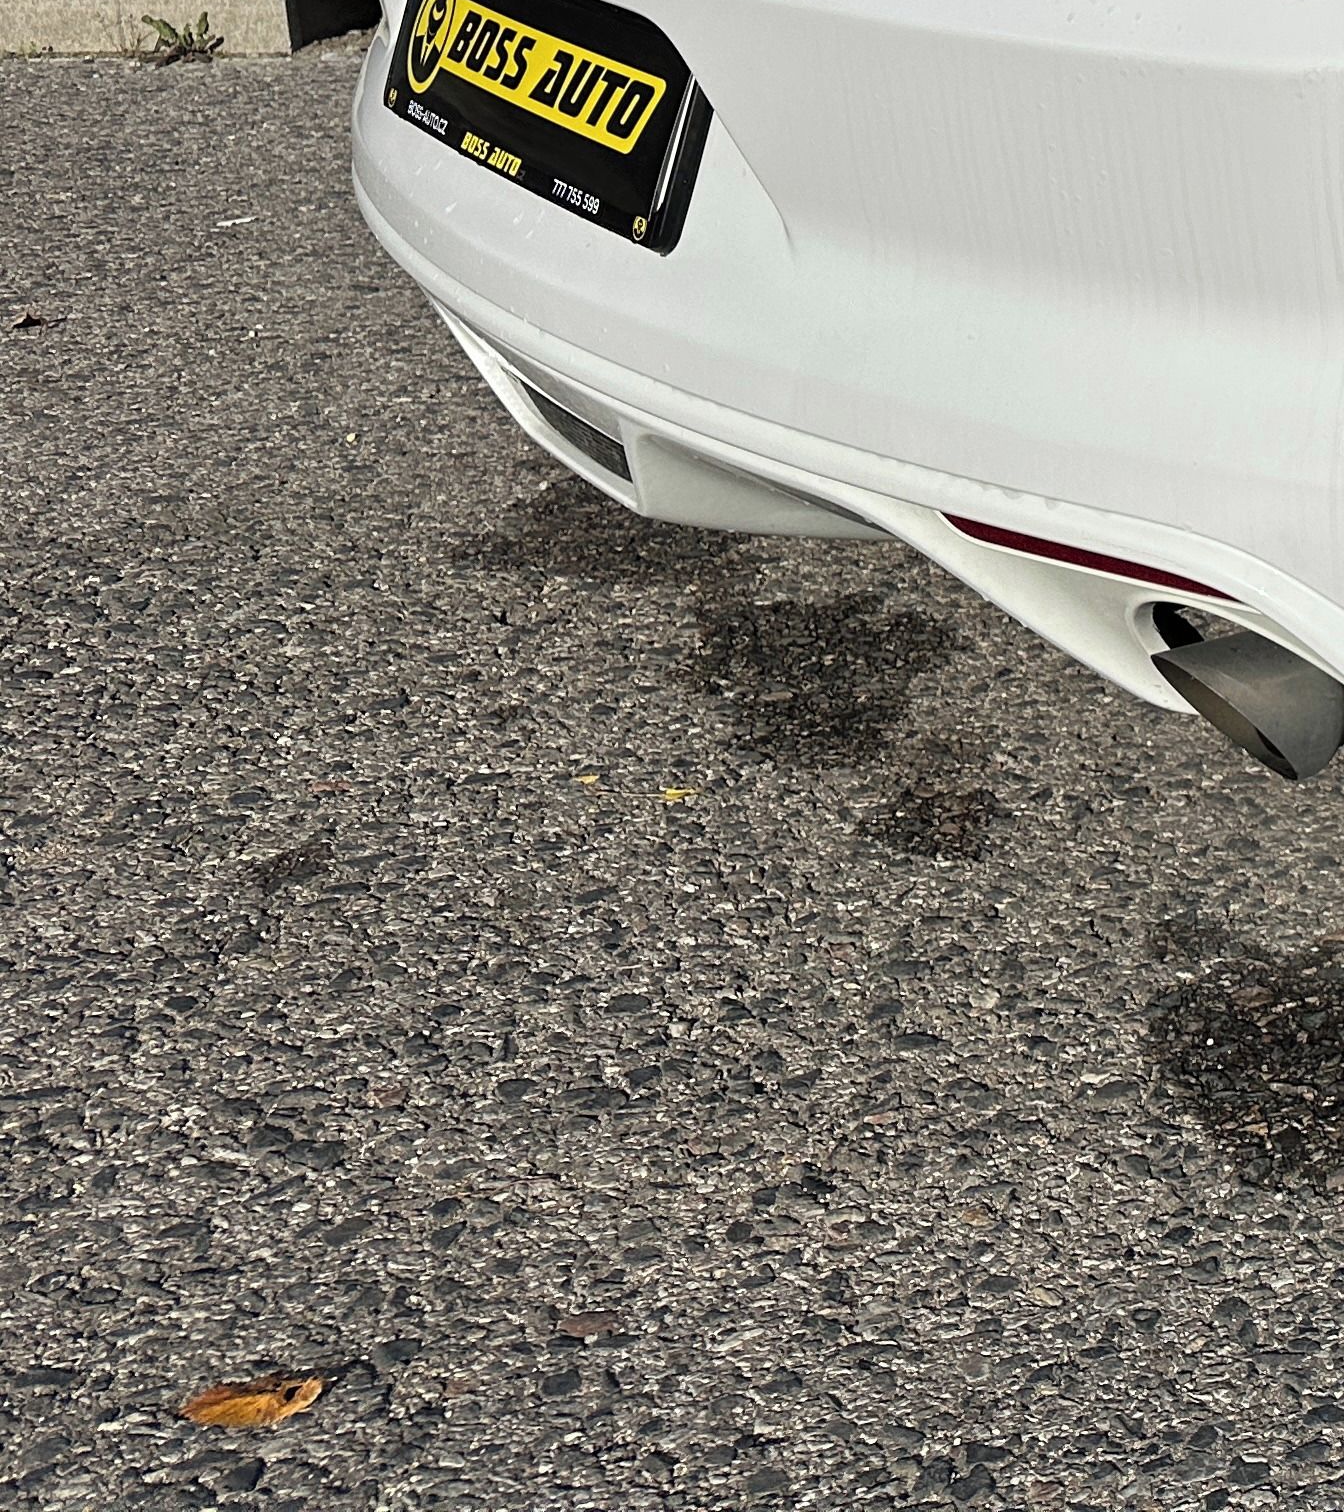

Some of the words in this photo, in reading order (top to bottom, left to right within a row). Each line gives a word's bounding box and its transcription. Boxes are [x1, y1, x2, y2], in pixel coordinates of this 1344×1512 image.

[447, 10, 537, 90] BOSS
[528, 49, 656, 139] AUTO
[460, 131, 490, 160] BOSS
[487, 147, 522, 177] AUTO
[552, 178, 567, 198] 777
[566, 186, 583, 206] 755
[582, 193, 600, 214] 599
